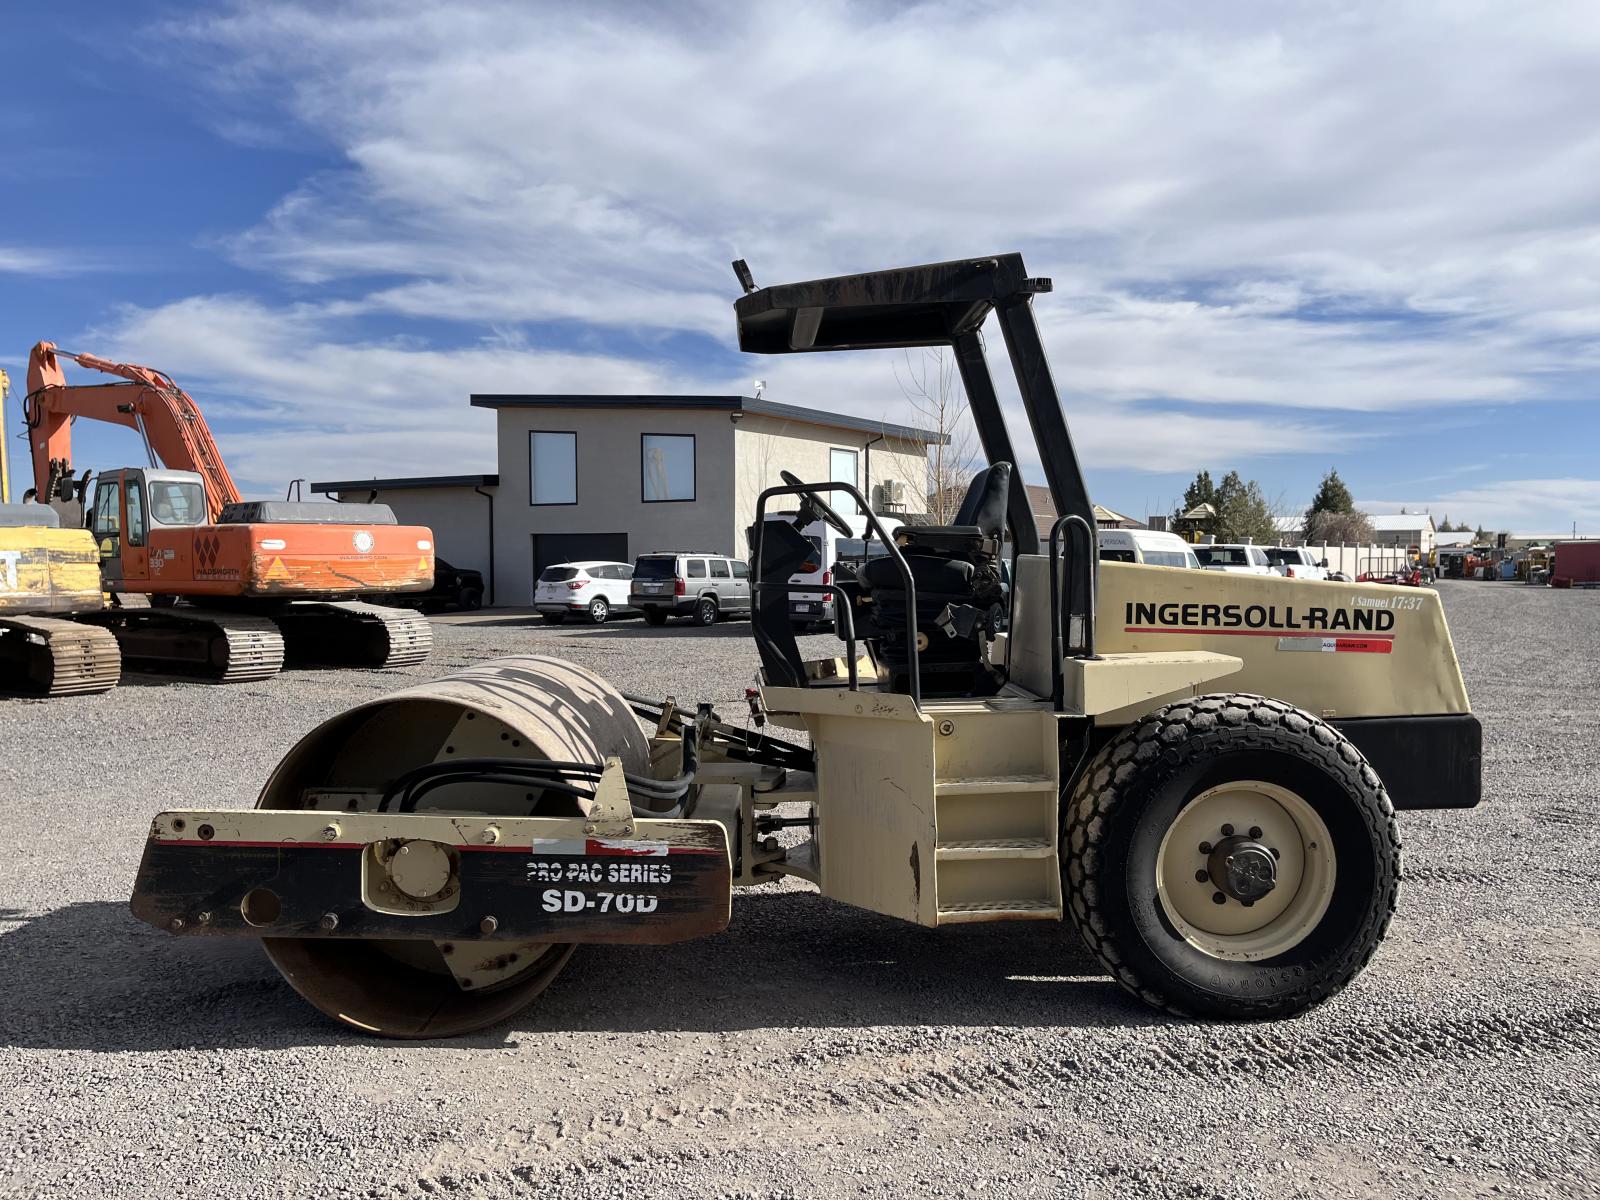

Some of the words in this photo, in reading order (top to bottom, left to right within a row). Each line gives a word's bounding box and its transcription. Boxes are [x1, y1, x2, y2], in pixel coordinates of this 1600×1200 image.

[149, 558, 164, 568] 330
[197, 568, 240, 576] WADSWORTH
[1357, 596, 1389, 608] Samuel
[1391, 595, 1424, 611] 17:37
[1125, 602, 1395, 631] INGERSOLL-RAND
[607, 863, 672, 883] SERIES
[541, 889, 658, 913] SD-70D
